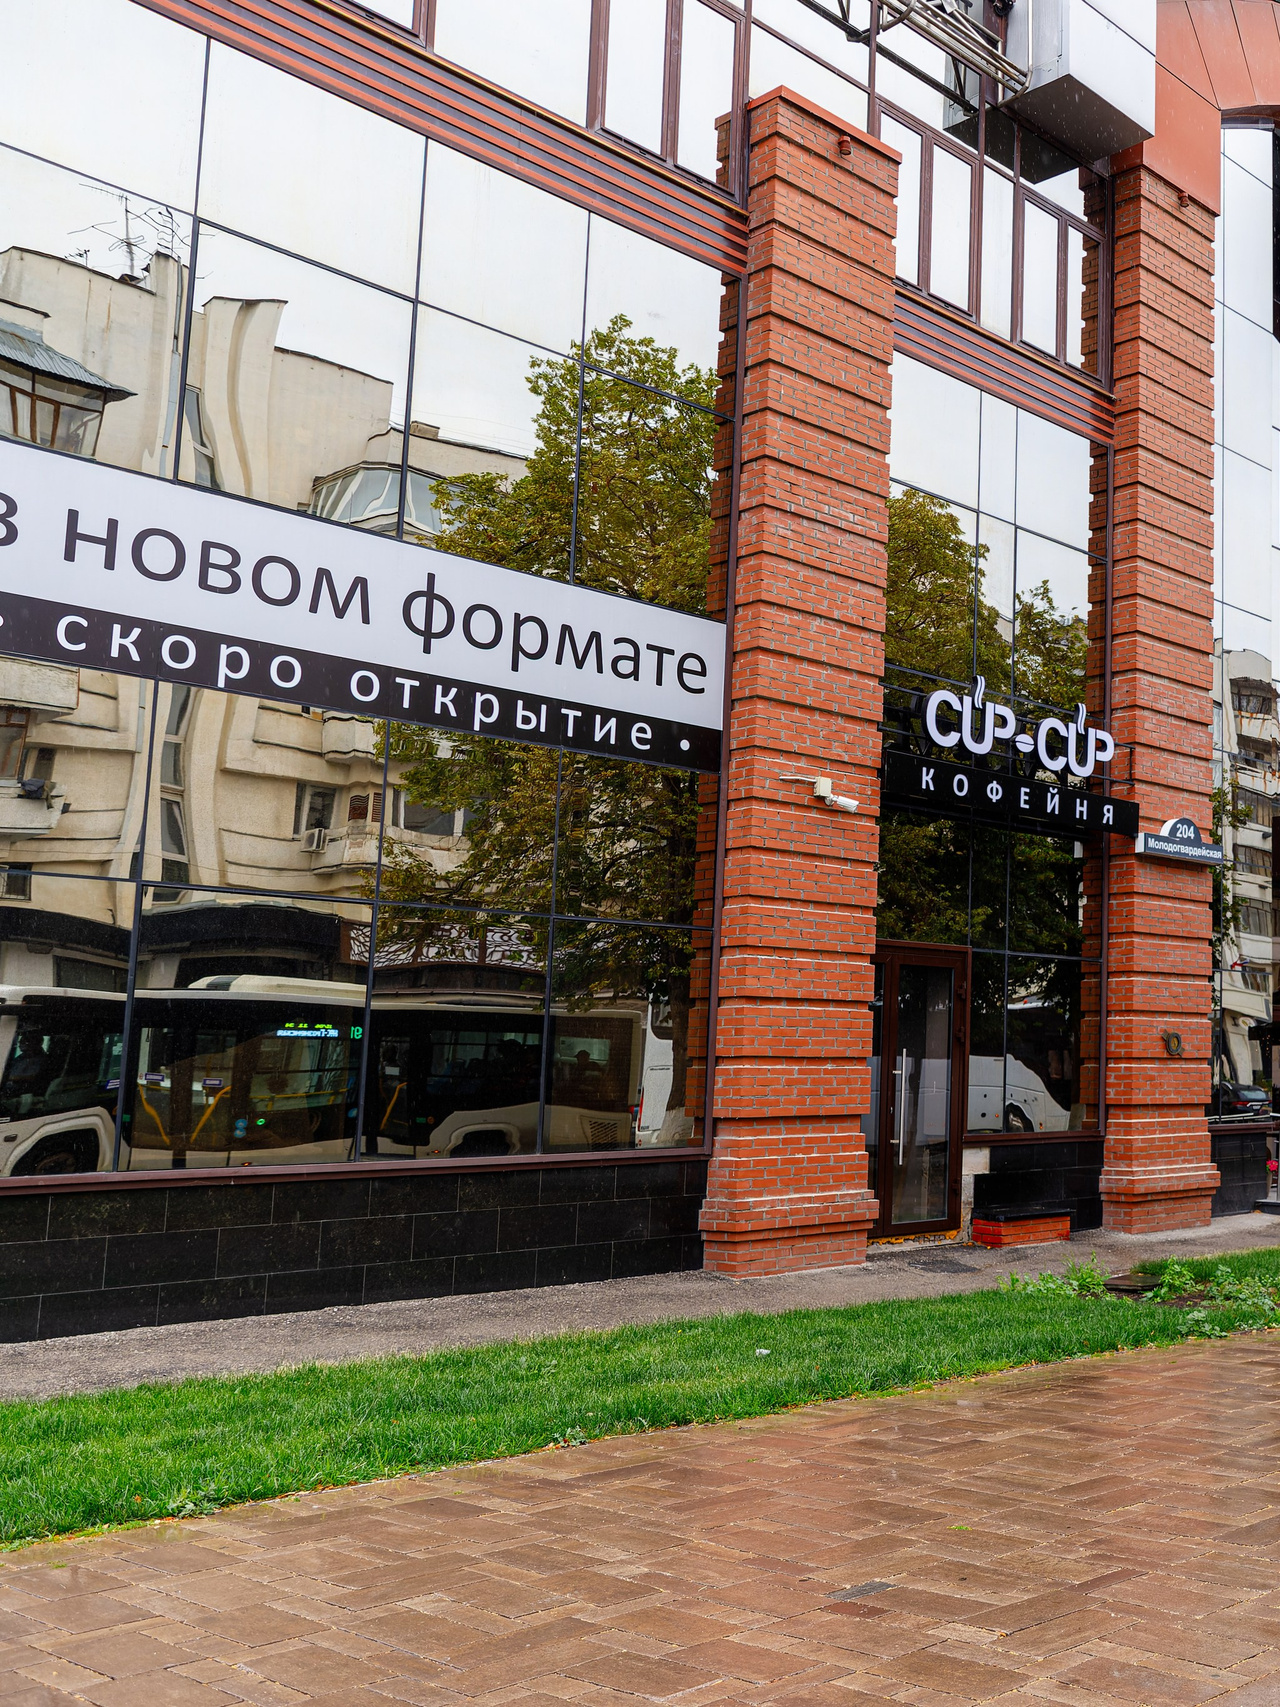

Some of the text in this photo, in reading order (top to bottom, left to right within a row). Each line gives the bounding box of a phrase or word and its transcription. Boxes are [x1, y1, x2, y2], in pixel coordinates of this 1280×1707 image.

[63, 508, 372, 626] новом
[402, 572, 708, 696] формате
[56, 614, 654, 751] скоро открытие
[921, 766, 1114, 826] КОФЕЙНЯ
[1147, 837, 1222, 859] Молодогвардейская
[1175, 823, 1195, 840] 204
